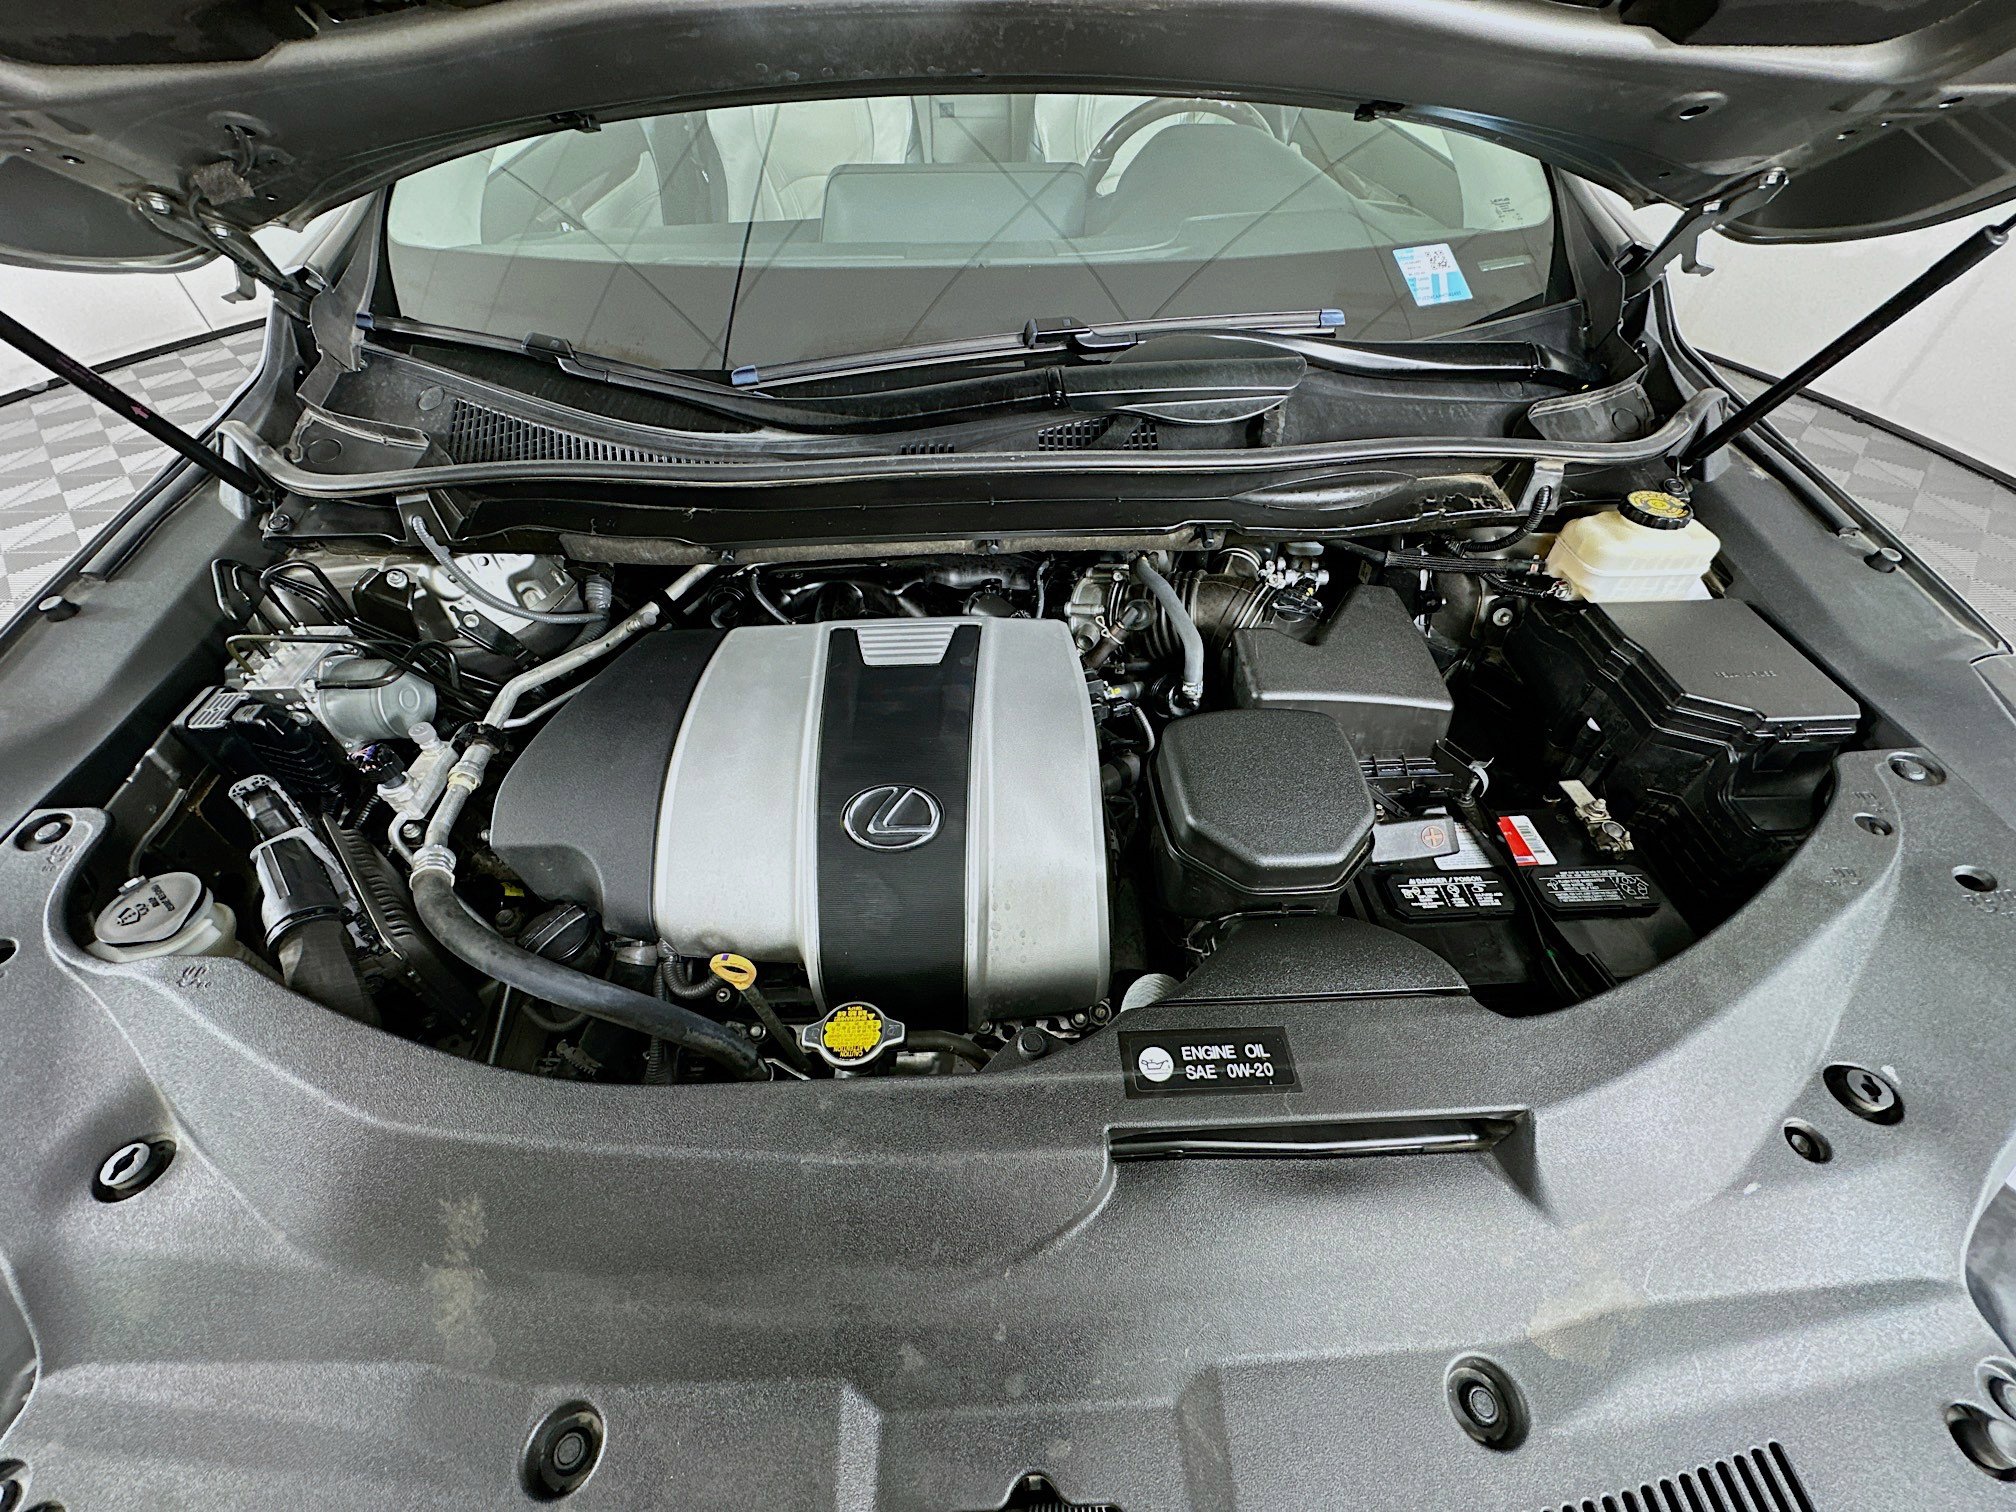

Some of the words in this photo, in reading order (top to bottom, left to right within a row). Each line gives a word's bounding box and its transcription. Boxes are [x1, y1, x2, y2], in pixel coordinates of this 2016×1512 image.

[1415, 877, 1448, 885] DANGER
[1453, 875, 1484, 883] POISON
[840, 1050, 864, 1058] CAUTION
[1181, 1044, 1237, 1061] ENGINE
[1244, 1043, 1271, 1059] OIL
[1185, 1064, 1218, 1080] SAE
[1226, 1062, 1275, 1079] 0W-20
